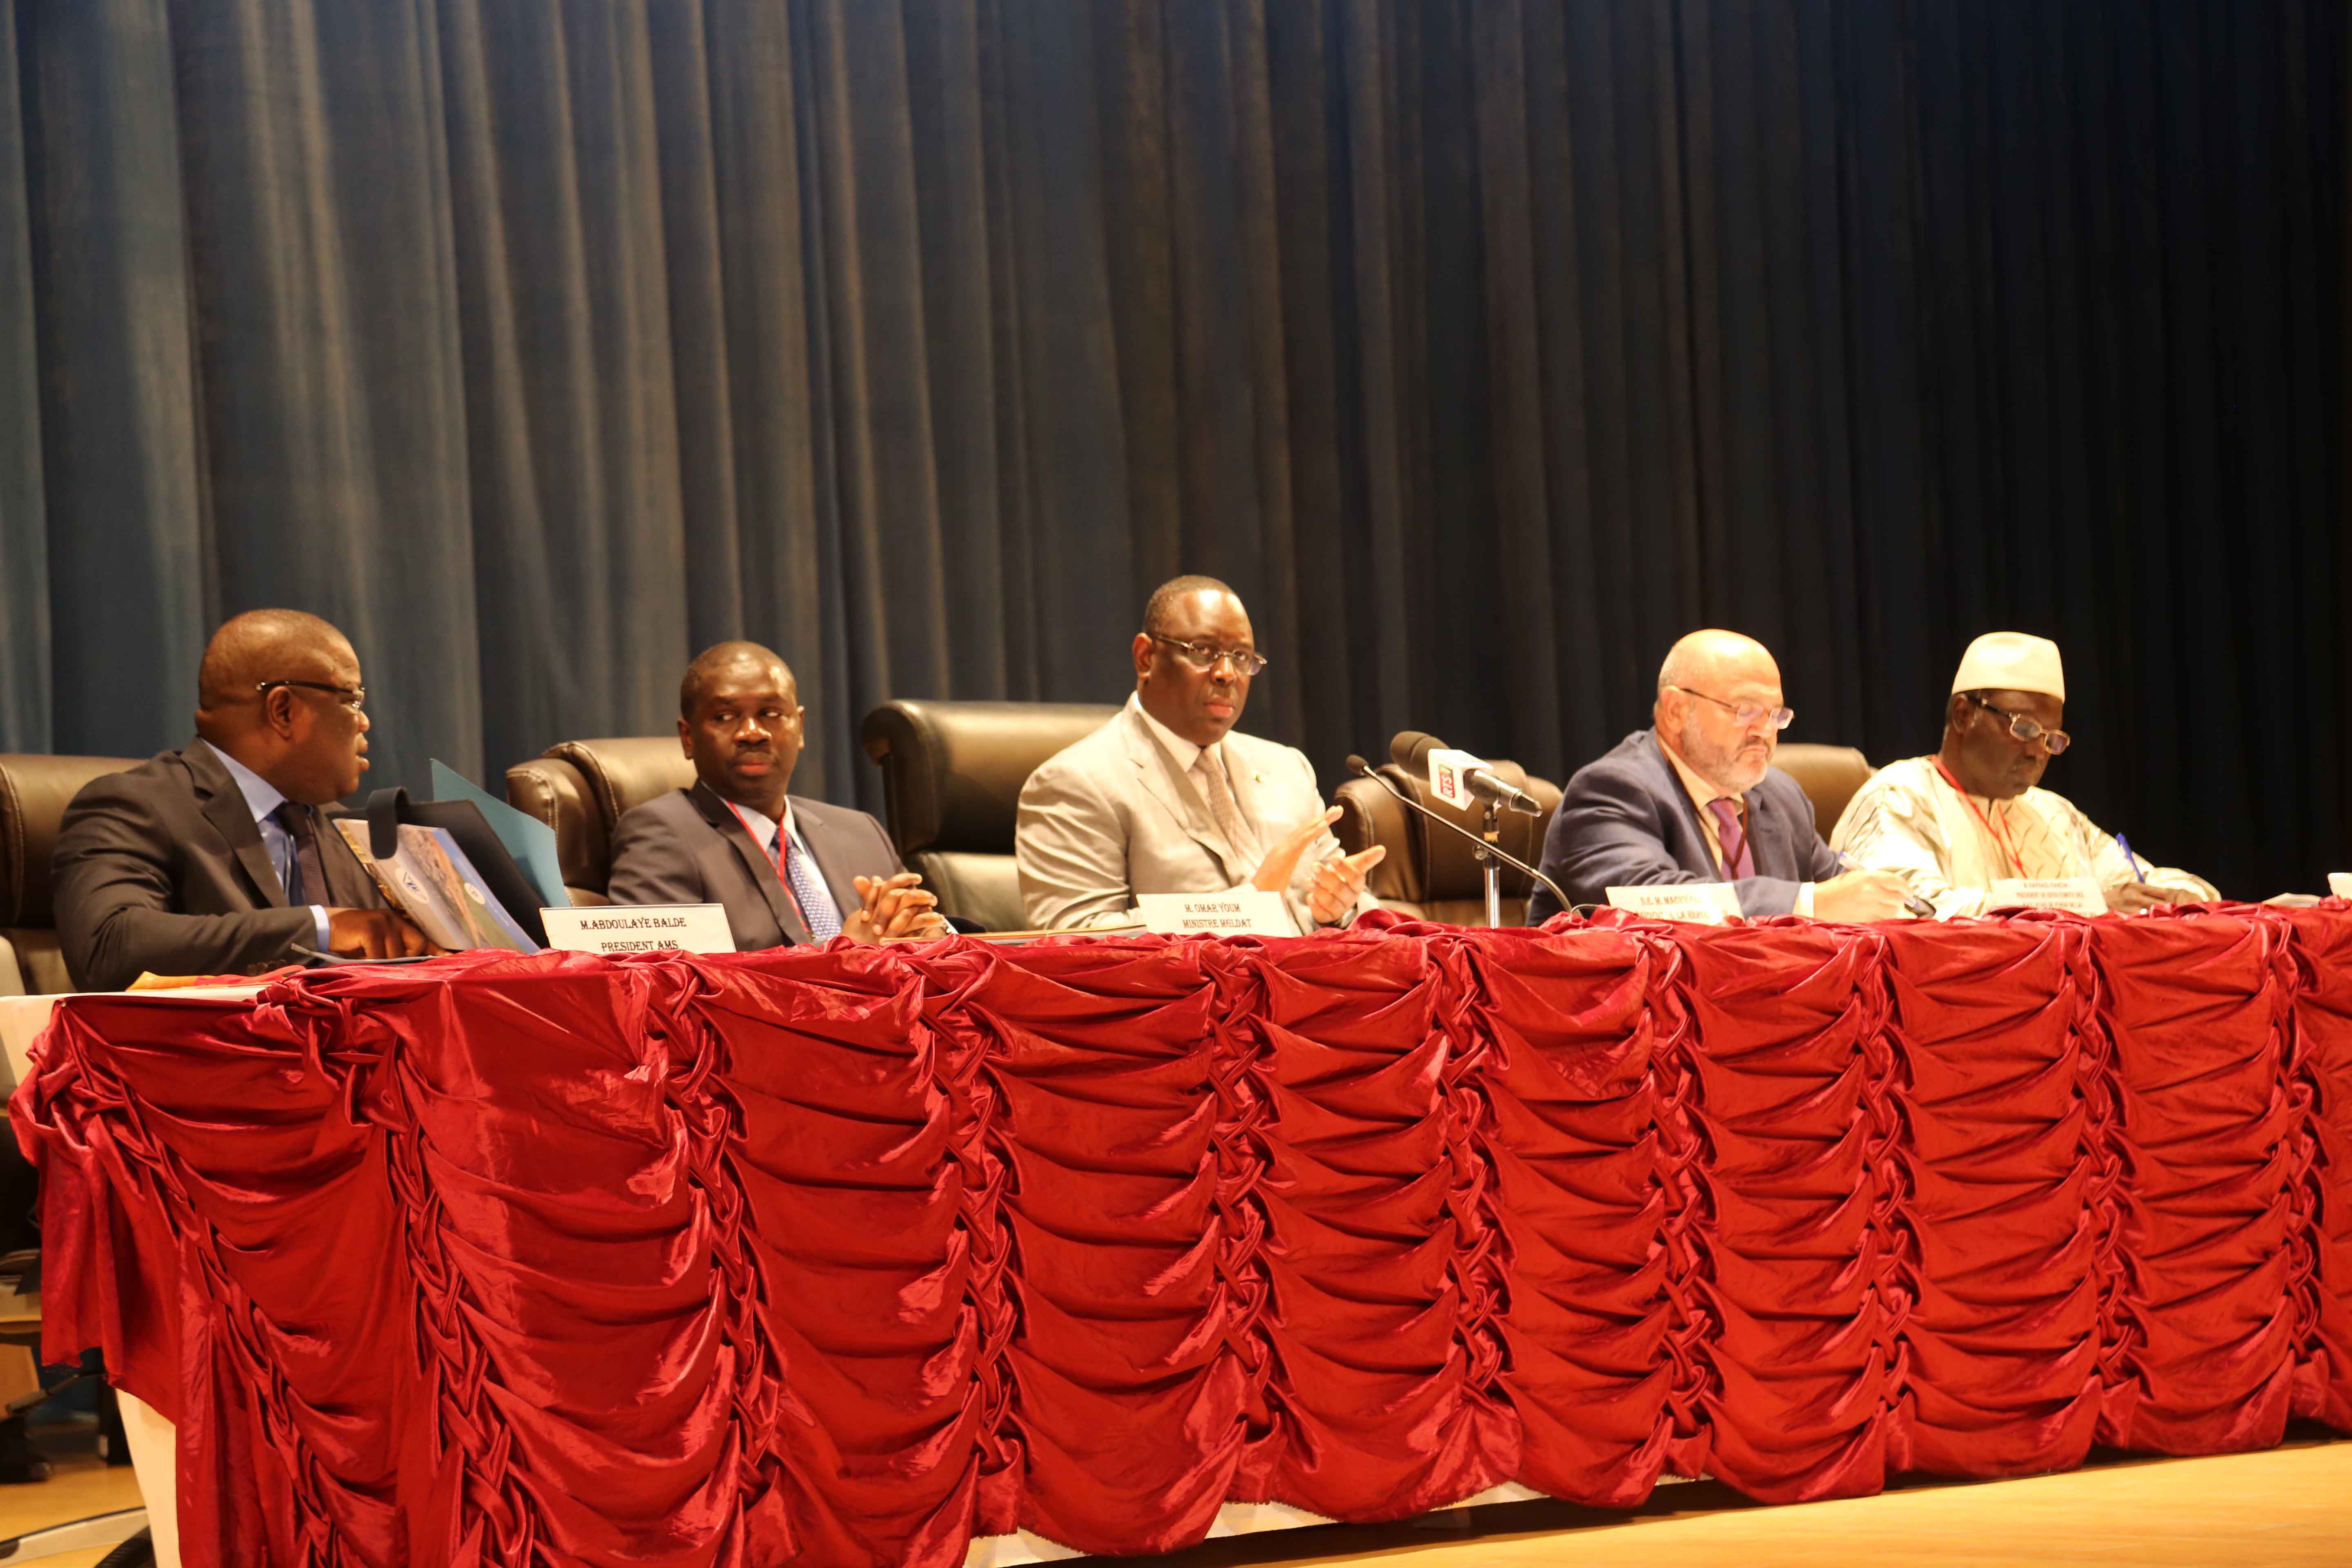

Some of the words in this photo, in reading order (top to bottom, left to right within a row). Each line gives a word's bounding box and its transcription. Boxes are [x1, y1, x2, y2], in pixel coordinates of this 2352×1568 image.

[1185, 904, 1194, 912] M.
[1194, 904, 1217, 913] OMAR
[1218, 902, 1241, 912] YOUM
[580, 918, 652, 930] M.ABDOULAYE
[653, 917, 687, 928] BALDE
[1183, 919, 1219, 928] MINISTRE
[601, 941, 653, 952] PRESIDENT
[657, 940, 679, 950] AMS
